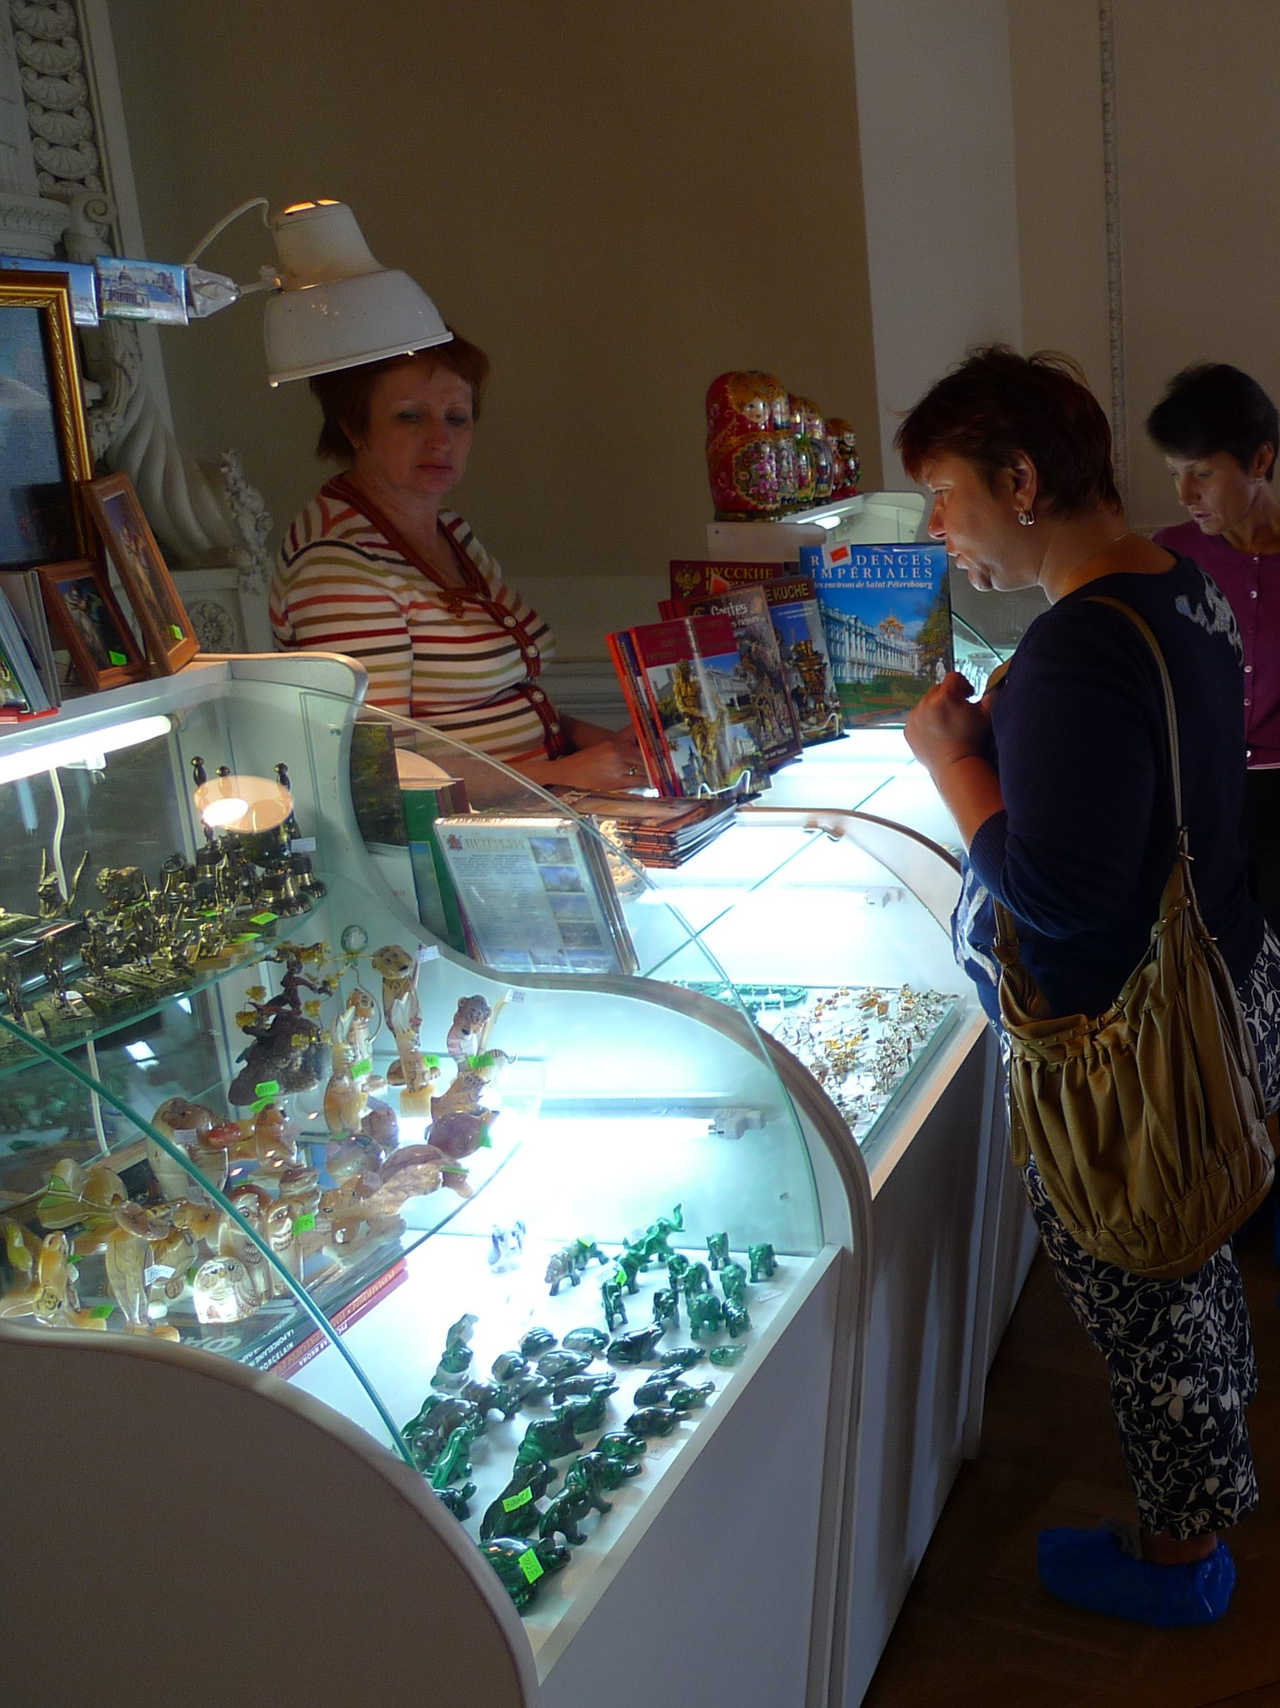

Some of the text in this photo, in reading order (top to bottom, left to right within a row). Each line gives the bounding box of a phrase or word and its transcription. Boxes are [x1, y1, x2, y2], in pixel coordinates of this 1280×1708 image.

[811, 554, 932, 566] RDENCES
[812, 566, 933, 579] IMPÉRIALES
[855, 580, 864, 588] de
[318, 1321, 348, 1349] РУСАЯ
